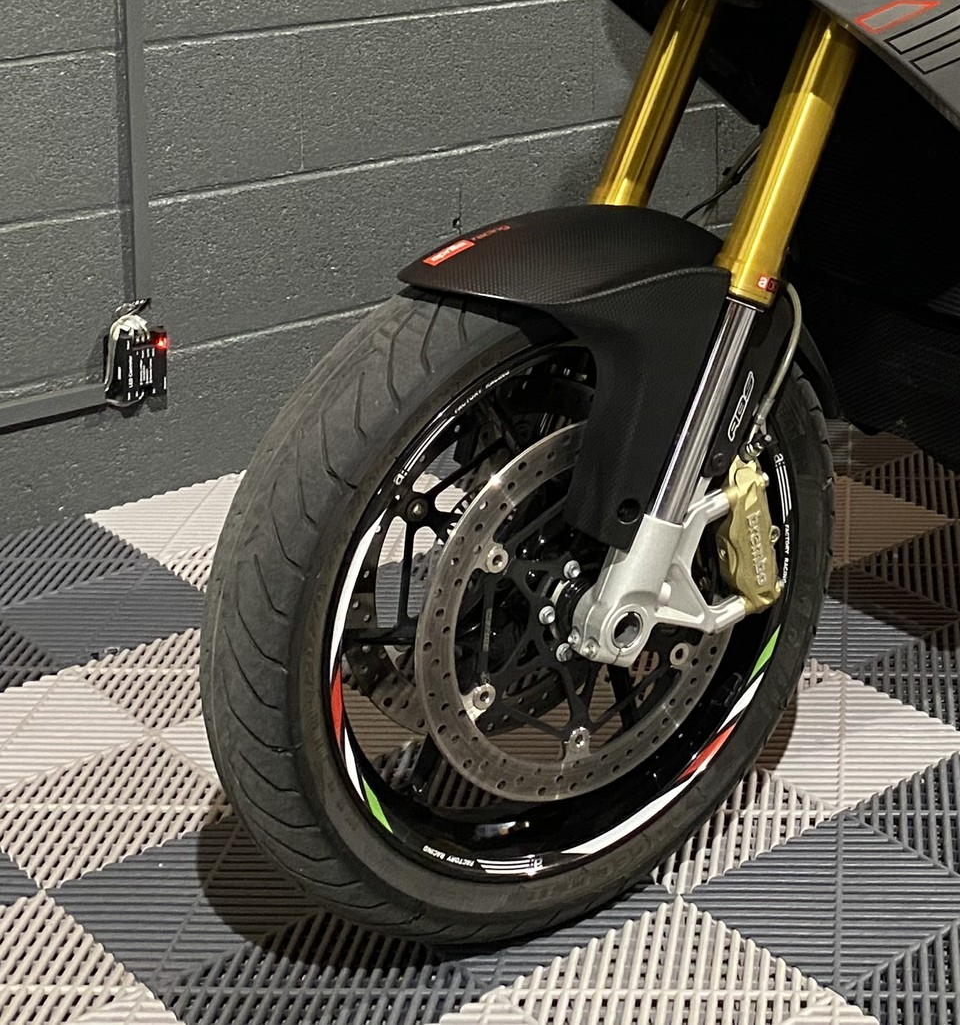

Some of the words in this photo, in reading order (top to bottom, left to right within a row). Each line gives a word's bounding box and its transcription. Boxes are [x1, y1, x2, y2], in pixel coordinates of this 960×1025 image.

[728, 371, 755, 442] ABS
[746, 510, 767, 587] brembo
[446, 855, 475, 867] FACTORY
